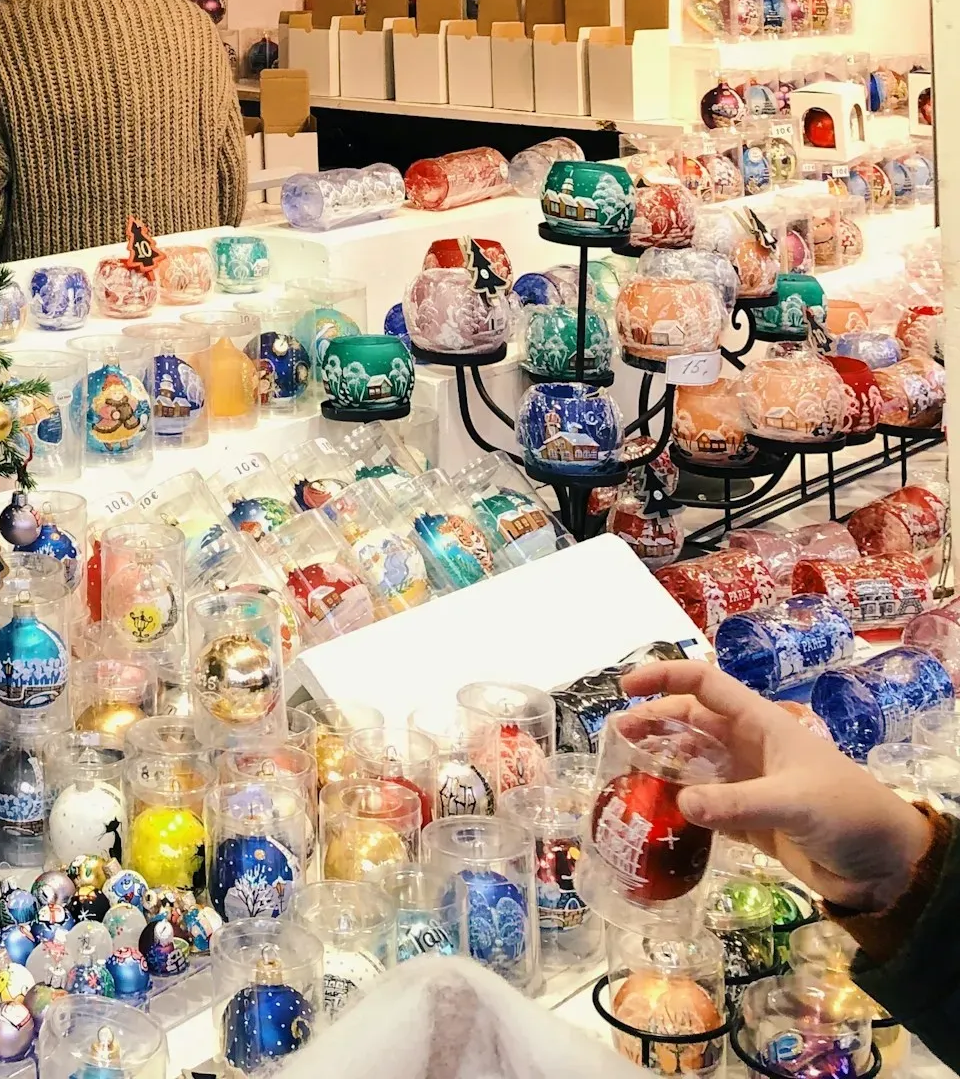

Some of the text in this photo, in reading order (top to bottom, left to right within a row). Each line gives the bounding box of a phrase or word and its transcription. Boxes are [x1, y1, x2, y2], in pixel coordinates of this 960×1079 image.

[135, 241, 152, 259] 10
[234, 458, 260, 475] 10 €
[105, 499, 121, 513] 10
[139, 497, 151, 510] 10
[728, 588, 751, 603] PARIS
[802, 636, 827, 653] PARIS
